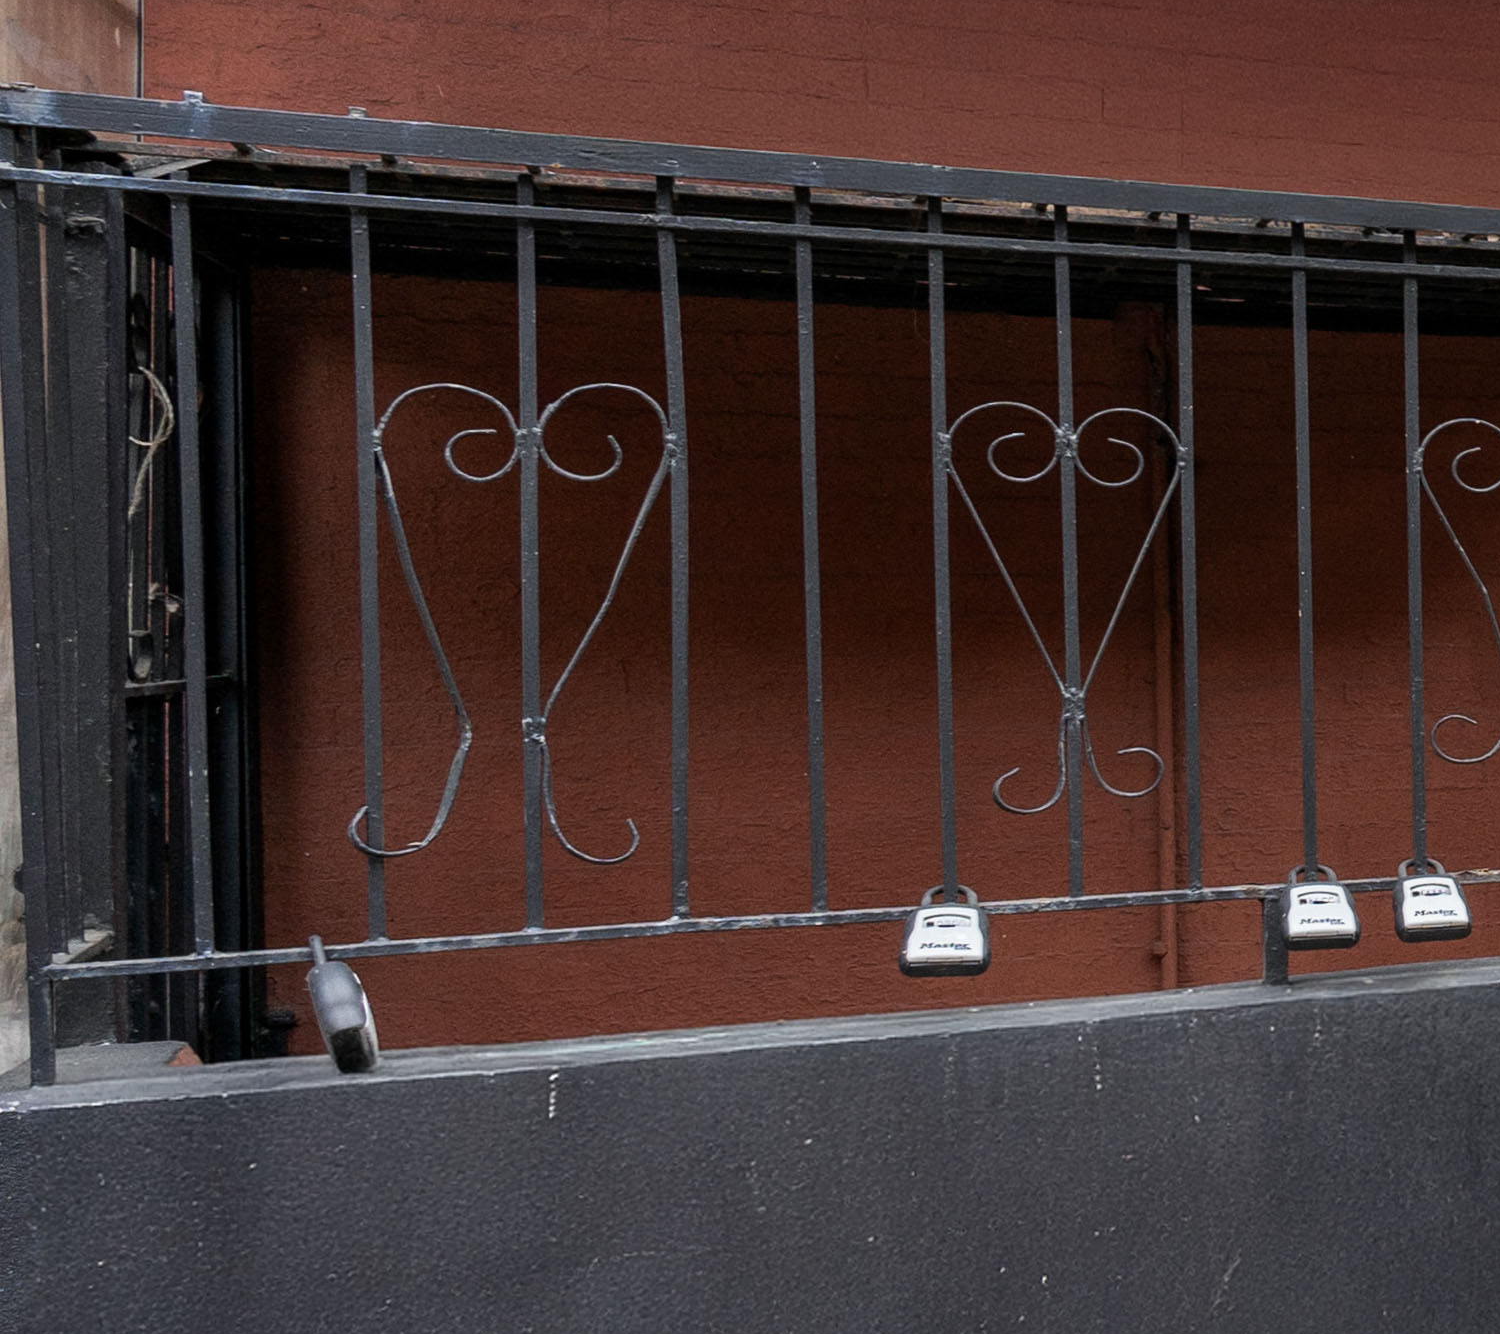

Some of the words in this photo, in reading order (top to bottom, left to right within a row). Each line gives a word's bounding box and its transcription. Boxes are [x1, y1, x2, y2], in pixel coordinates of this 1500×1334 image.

[1414, 909, 1455, 917] Master
[1300, 917, 1343, 925] Master
[920, 942, 969, 950] Master
